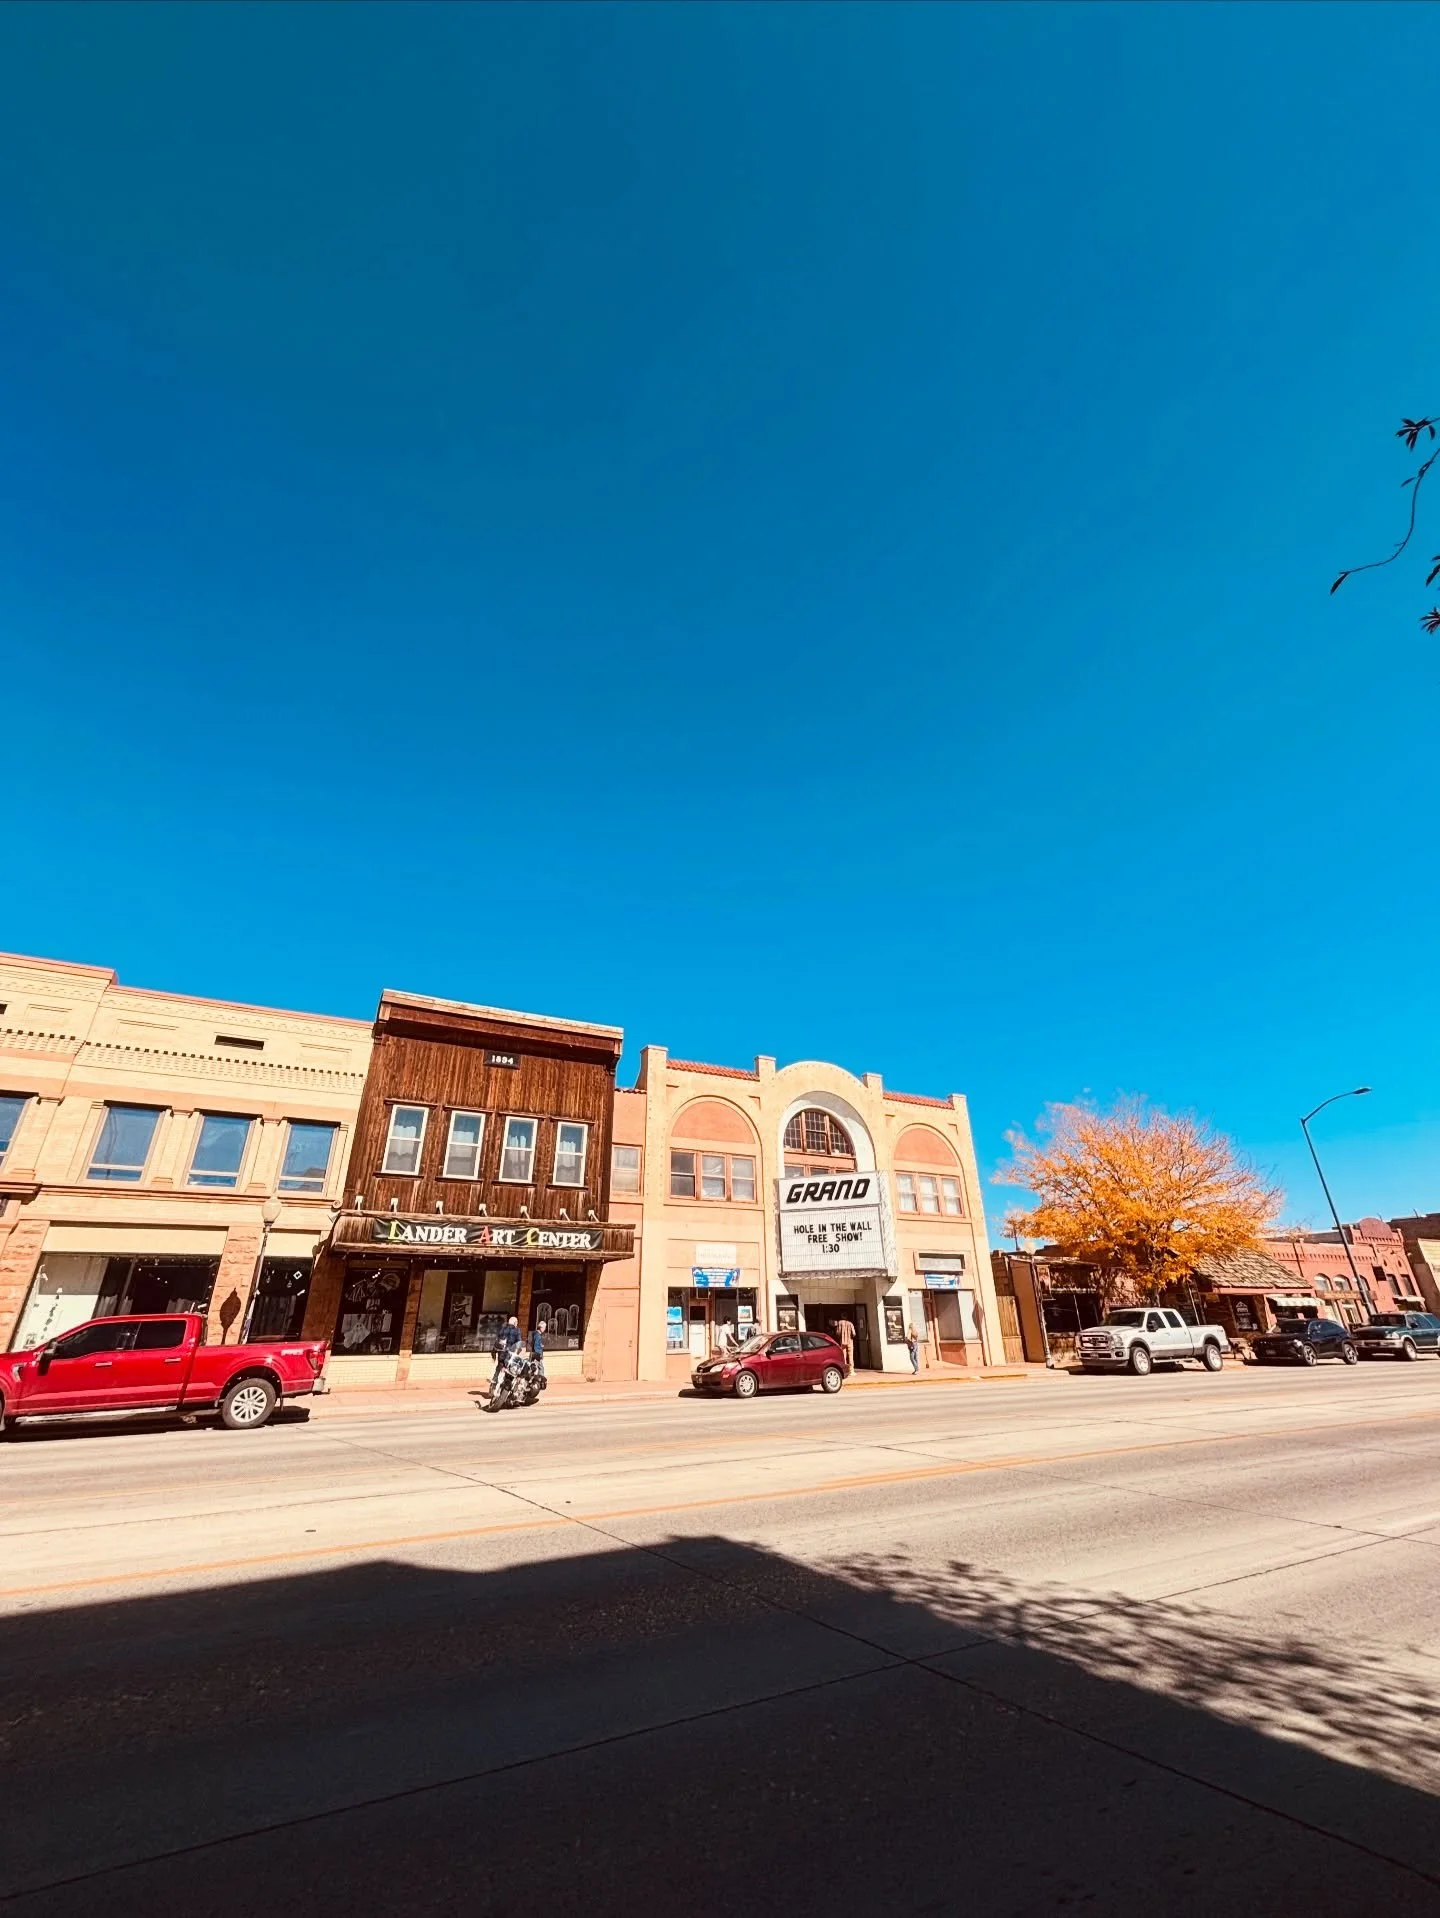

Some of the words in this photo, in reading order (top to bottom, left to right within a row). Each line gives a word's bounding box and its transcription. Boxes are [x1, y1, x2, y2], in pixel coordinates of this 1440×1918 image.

[786, 1178, 870, 1204] GRAND
[794, 1224, 814, 1234] HOLE
[818, 1223, 827, 1232] IN
[830, 1222, 847, 1232] THE
[849, 1221, 872, 1231] WALL
[388, 1220, 467, 1244] LANDER
[479, 1225, 516, 1245] ART
[526, 1227, 591, 1249] CENTER
[807, 1233, 828, 1244] FREE
[835, 1232, 863, 1242] SHOW!
[822, 1243, 840, 1253] 1:30
